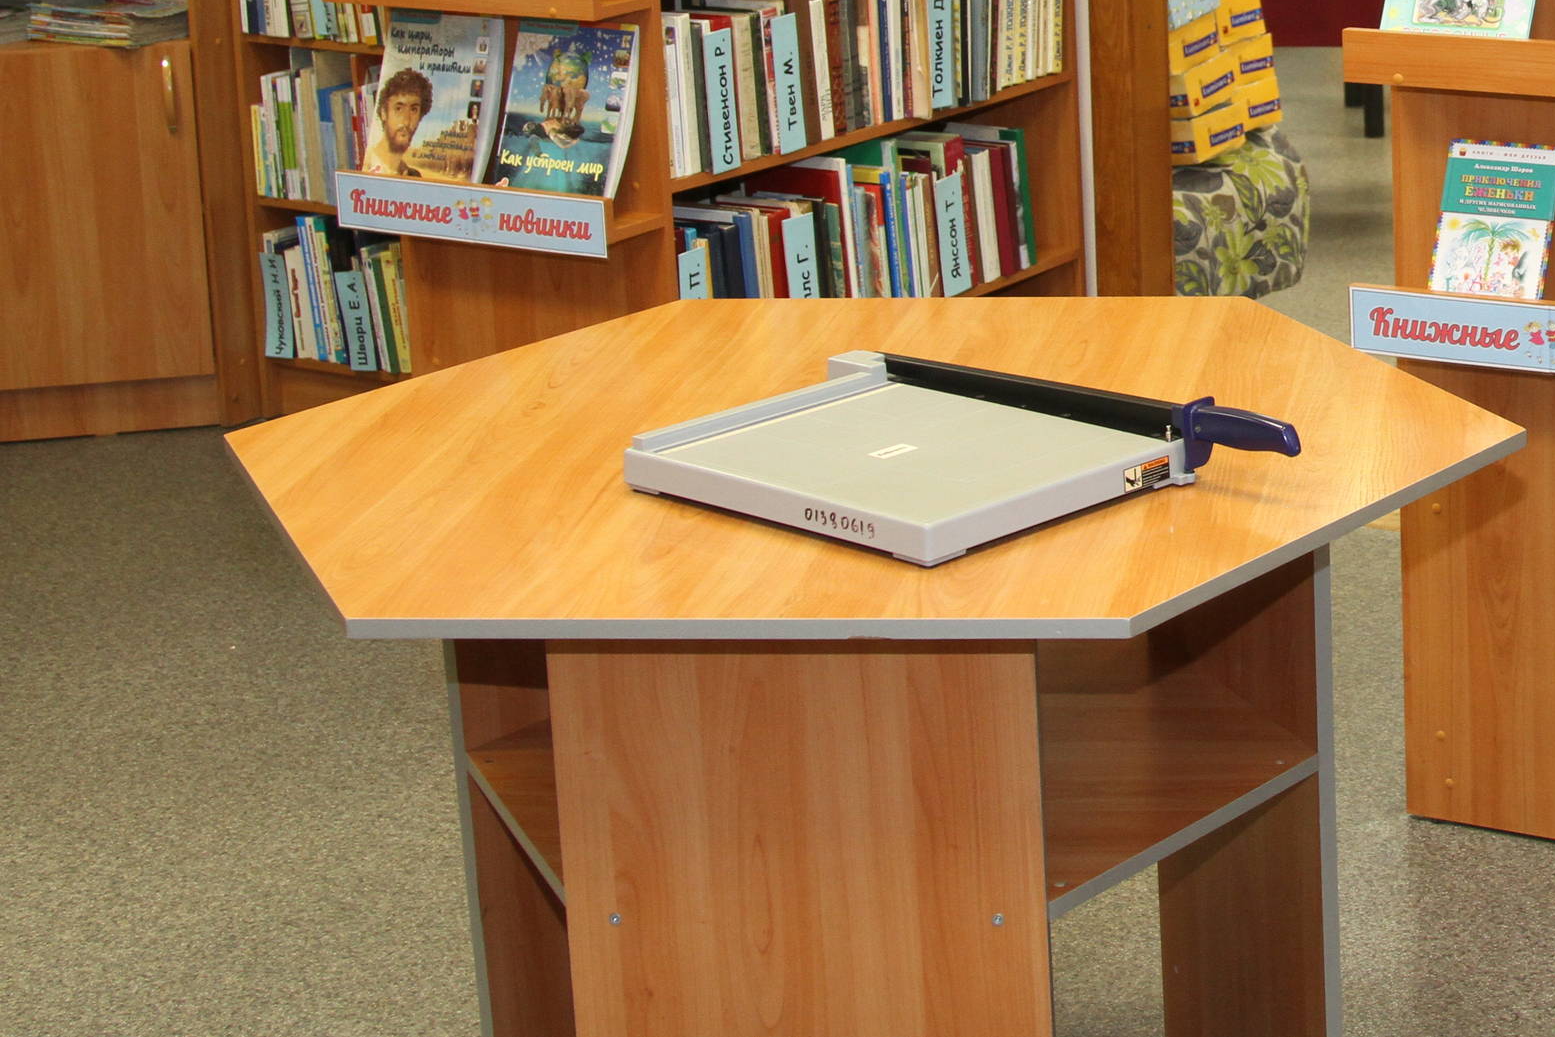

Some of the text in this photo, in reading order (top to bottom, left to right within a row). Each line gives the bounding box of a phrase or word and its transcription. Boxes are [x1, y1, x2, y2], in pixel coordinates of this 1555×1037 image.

[398, 44, 455, 61] императоры
[426, 61, 472, 76] правители
[932, 19, 944, 98] Толкиен
[714, 37, 734, 164] Стивенсон Р.
[783, 51, 797, 132] Твен М.
[500, 149, 603, 181] Как устроен мир
[1461, 174, 1542, 188] ПРИКЛЮЧЕНИЯ
[350, 188, 592, 241] Книжные новинки
[1464, 183, 1535, 201] ЁЖЕНЬКИ
[949, 217, 962, 279] Янссон
[272, 289, 287, 355] Чуковский
[354, 316, 368, 366] Шварц
[1369, 306, 1521, 350] Книжные
